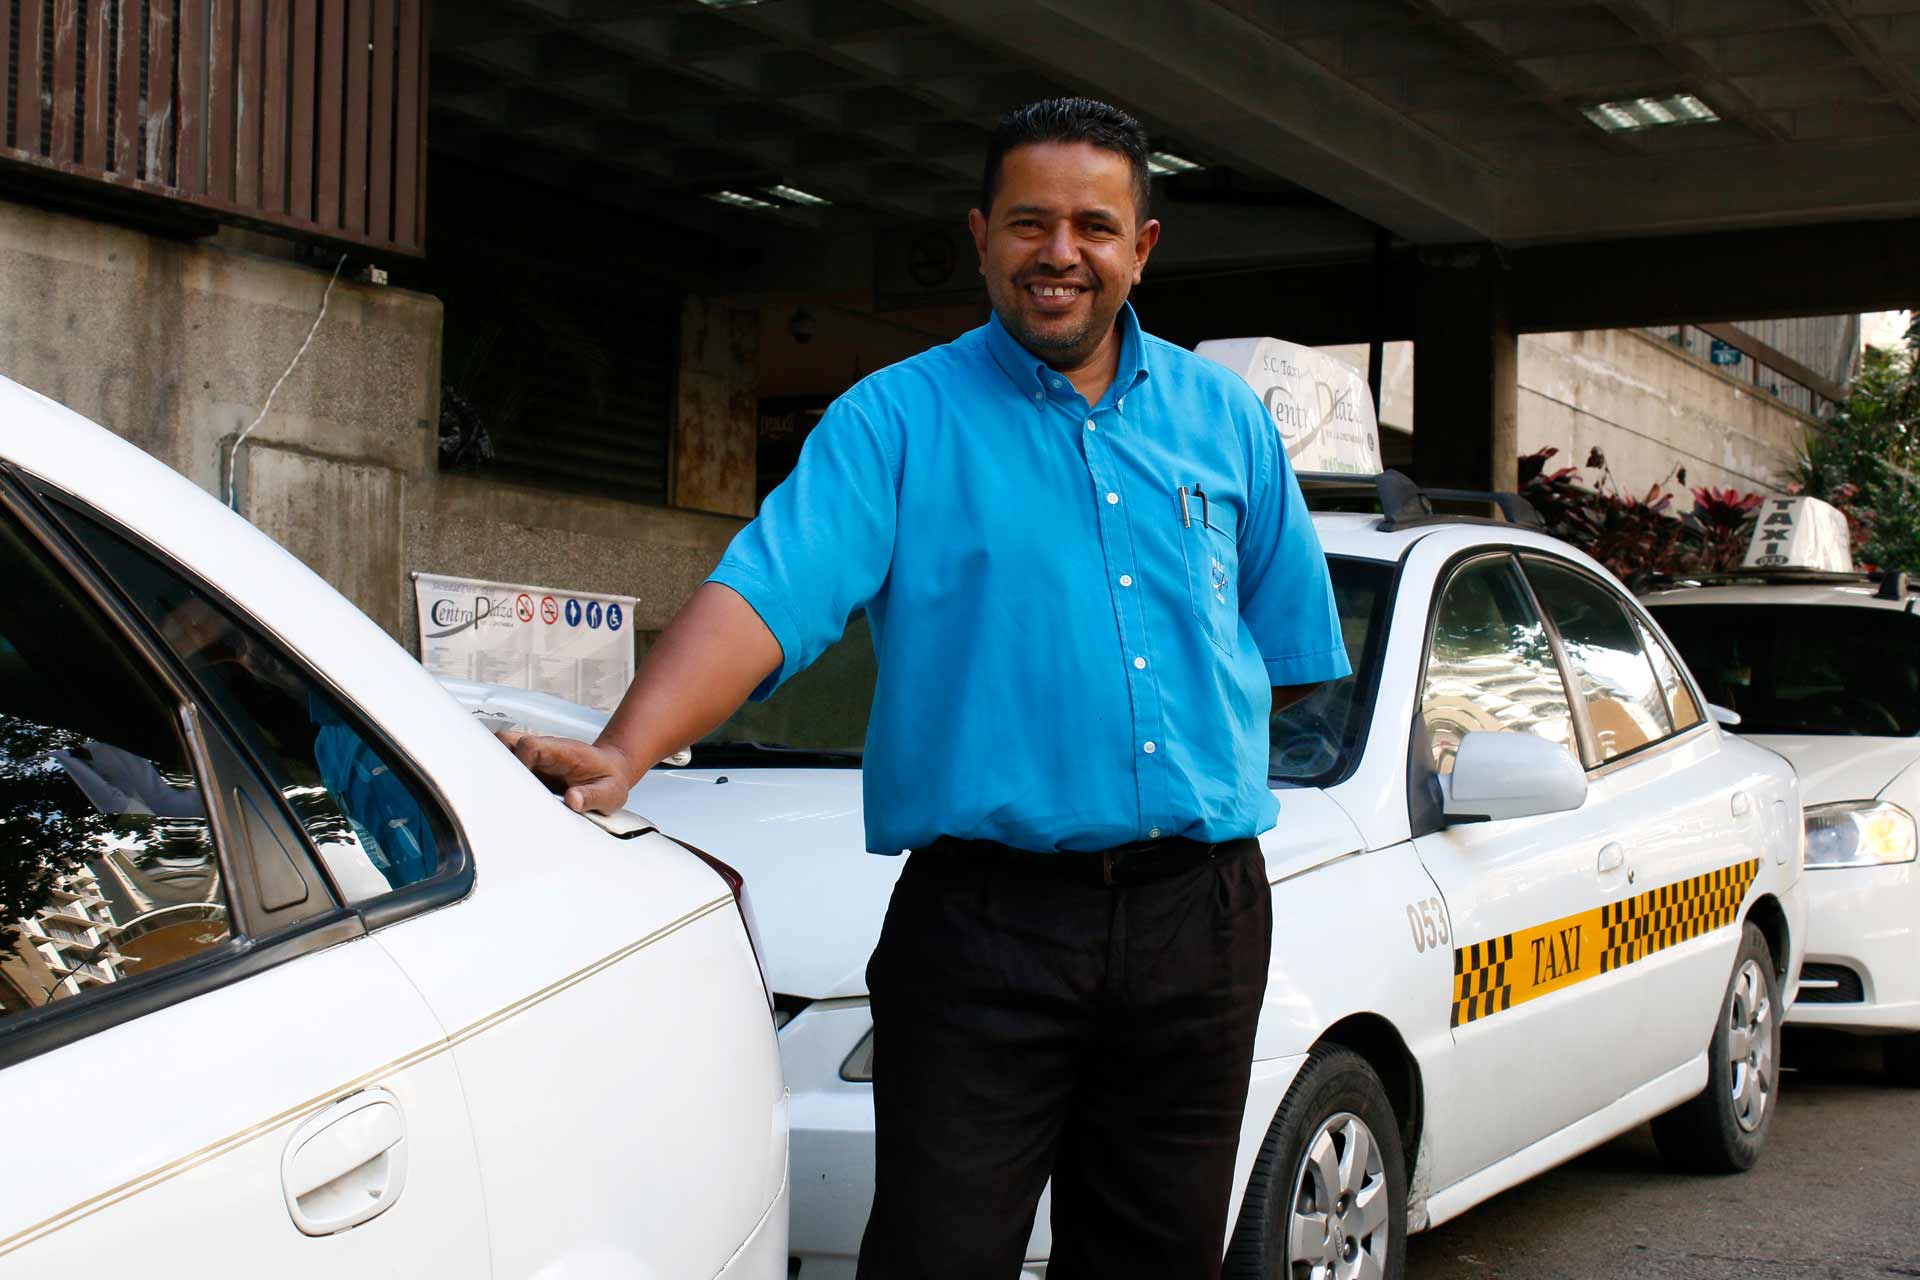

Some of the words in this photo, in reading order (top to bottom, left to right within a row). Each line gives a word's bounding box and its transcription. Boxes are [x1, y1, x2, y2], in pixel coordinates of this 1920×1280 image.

[1760, 499, 1796, 554] TAXI
[1406, 896, 1449, 953] 053
[1530, 925, 1582, 987] TAXI
